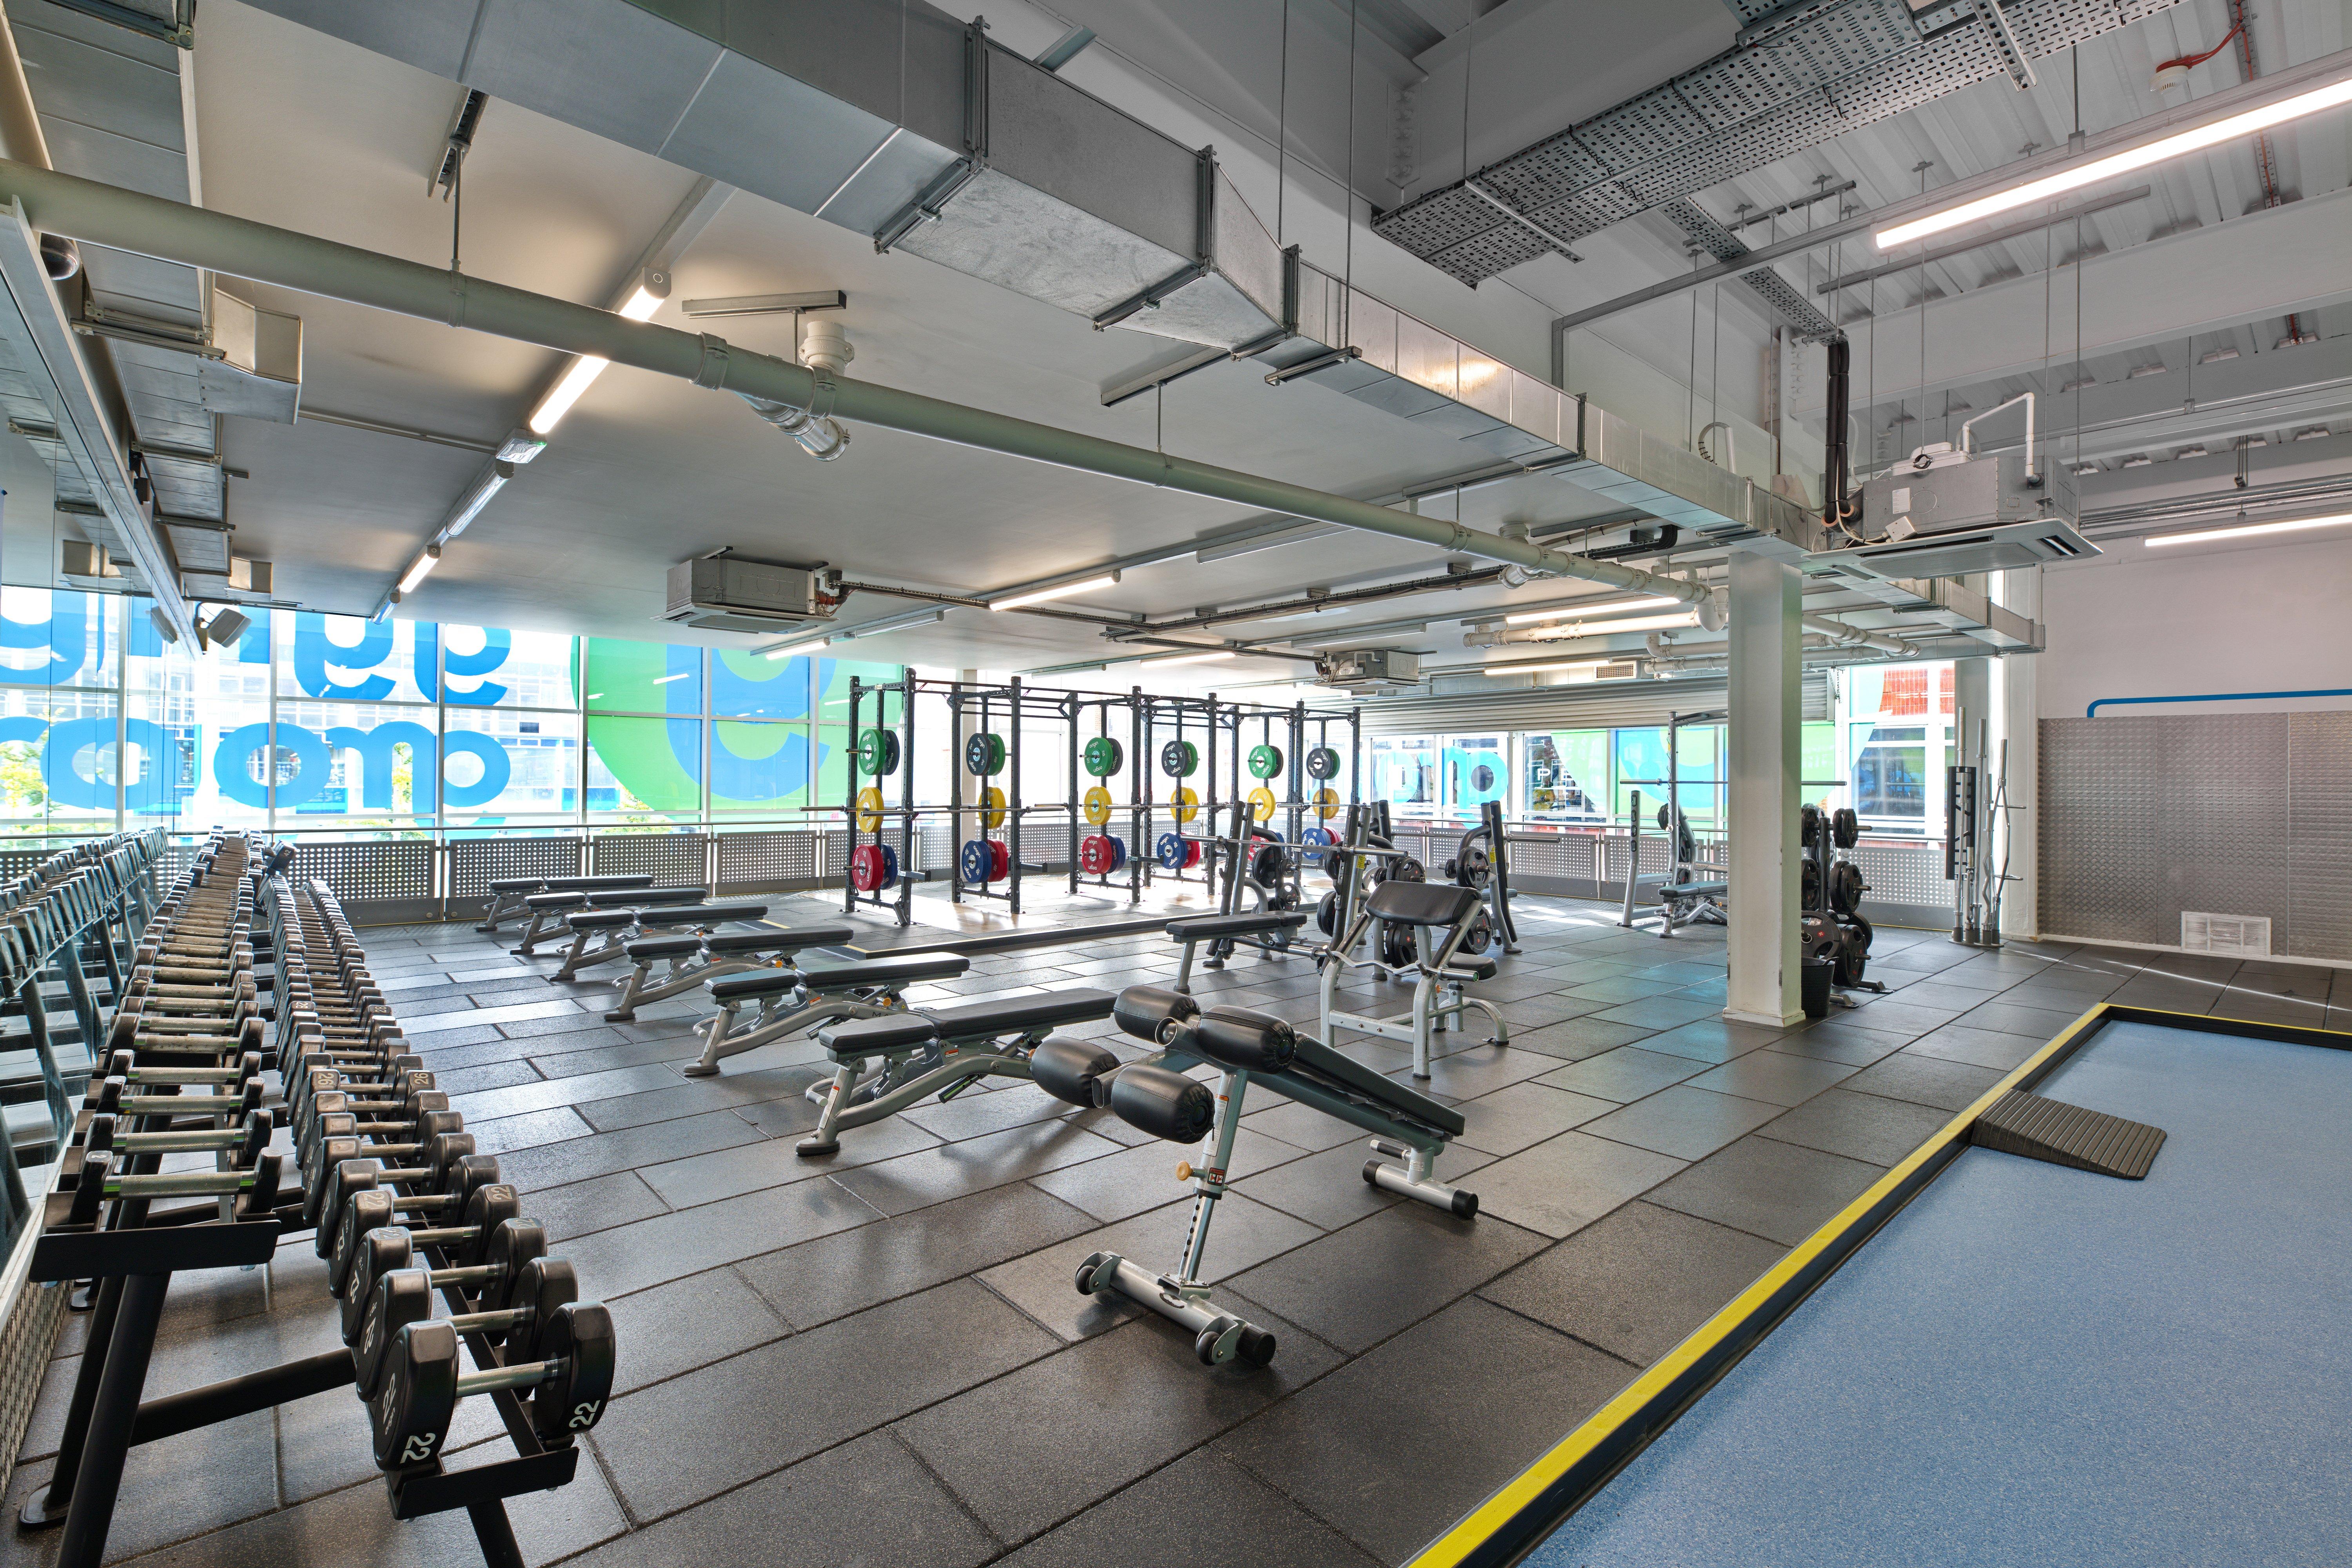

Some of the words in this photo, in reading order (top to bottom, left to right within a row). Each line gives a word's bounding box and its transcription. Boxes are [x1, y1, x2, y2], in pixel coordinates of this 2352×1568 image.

[1261, 765, 1270, 775] origin
[1160, 836, 1169, 845] origin
[1169, 857, 1178, 866] origin
[1714, 909, 1726, 918] MATRIX
[318, 1073, 334, 1085] 26
[414, 1073, 429, 1085] 26
[492, 1185, 513, 1200] 22
[364, 1193, 387, 1208] 22
[518, 1217, 536, 1229] 22
[379, 1228, 404, 1239] 22
[383, 1372, 396, 1425] 22
[569, 1400, 601, 1428] 22
[399, 1433, 436, 1464] 22
